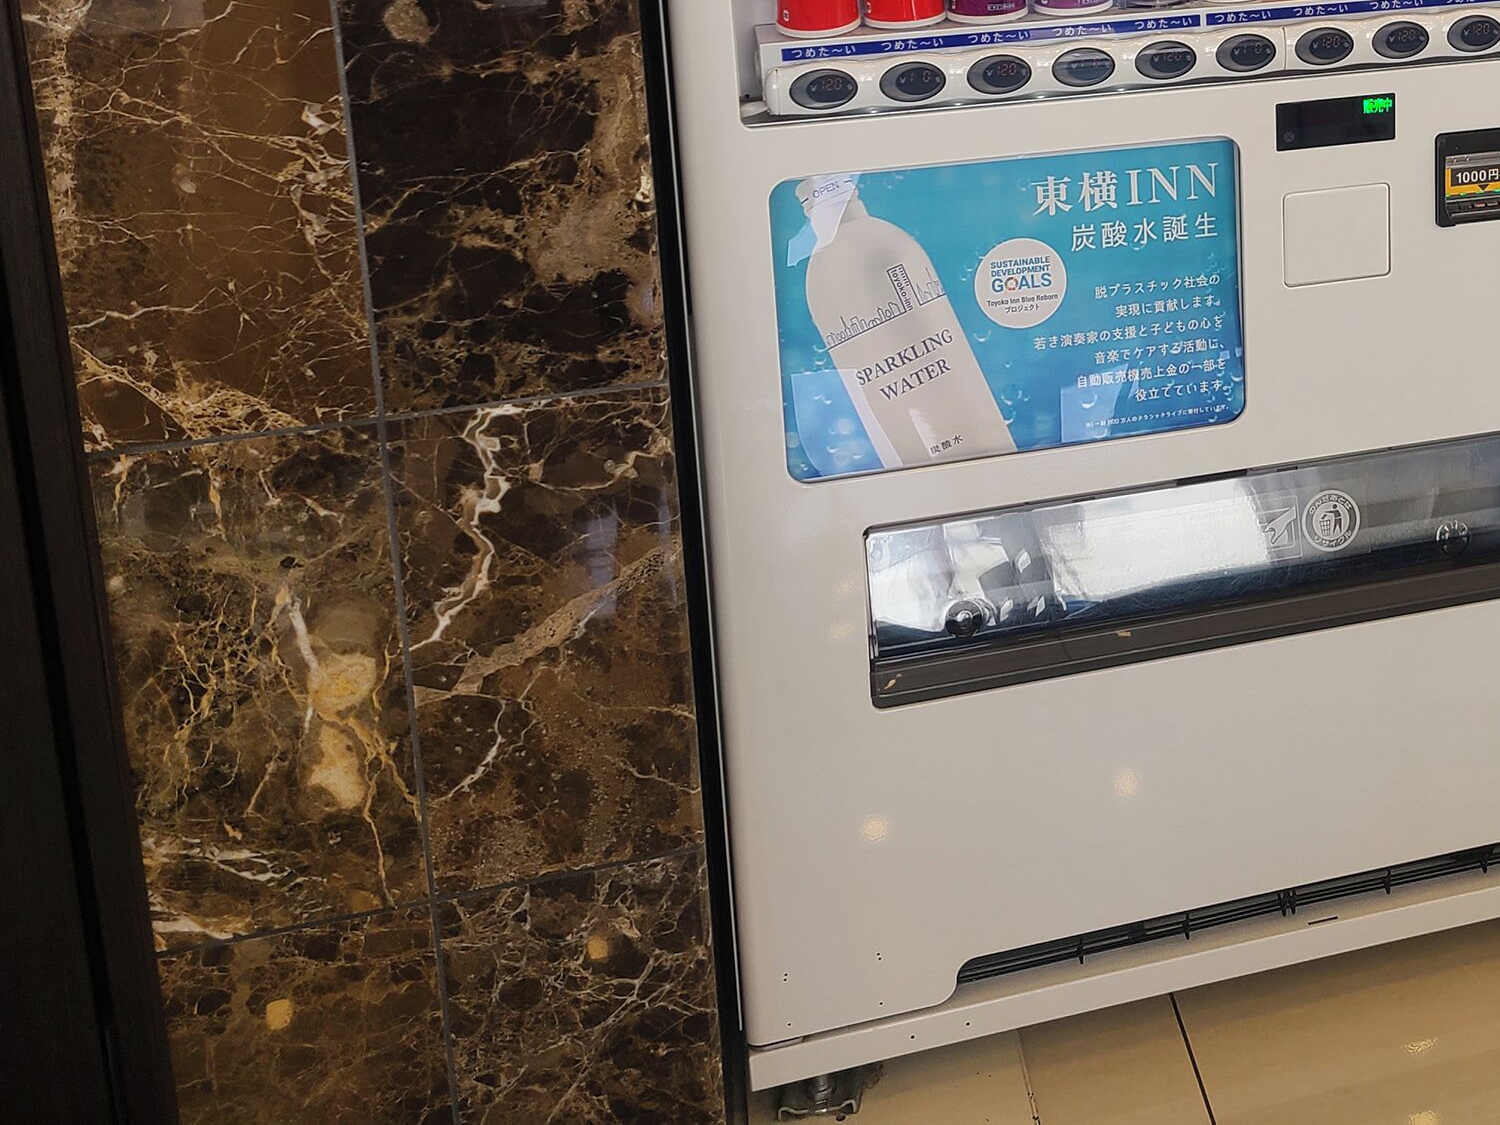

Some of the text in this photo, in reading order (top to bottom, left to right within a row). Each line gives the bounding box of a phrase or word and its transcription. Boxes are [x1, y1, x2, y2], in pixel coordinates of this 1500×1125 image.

[1362, 97, 1393, 115] 販売中
[811, 180, 841, 200] OPEN
[1029, 161, 1219, 218] 東横INN
[1070, 211, 1219, 253] 炭酸水誕生
[990, 255, 1051, 270] SUSTAINABLE
[991, 264, 1051, 278] DEVELOPMENT
[991, 272, 1052, 293] GOALS
[1094, 273, 1221, 300] 脱プラスチック社会の
[1004, 303, 1040, 314] プロジェクト
[1115, 294, 1221, 319] 実現に貢献します。
[1033, 315, 1224, 351] 若き演奏家の支援と子どもの心を
[854, 328, 955, 388] SPARKLING
[1094, 338, 1225, 365] 音楽でケアする活動に、
[878, 357, 952, 403] WATER
[1076, 358, 1227, 389] 自動販売機売上金の一部を
[1134, 378, 1230, 402] 役立てています。
[929, 435, 963, 456] 炭酸水
